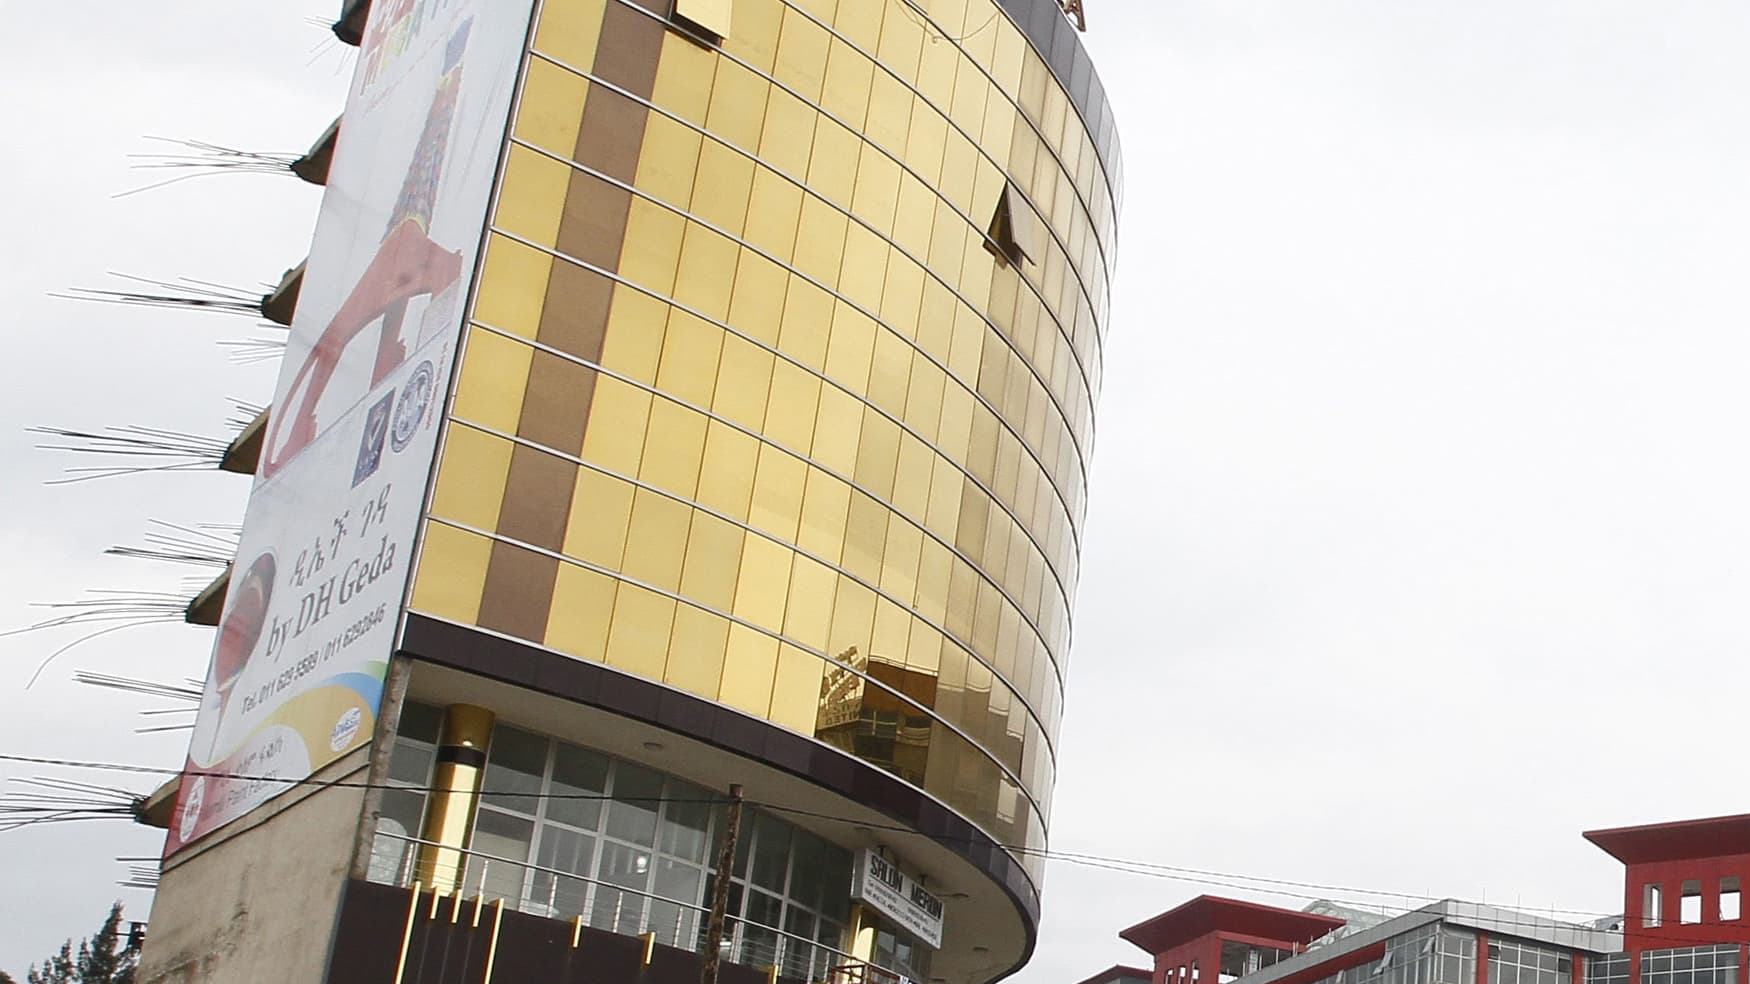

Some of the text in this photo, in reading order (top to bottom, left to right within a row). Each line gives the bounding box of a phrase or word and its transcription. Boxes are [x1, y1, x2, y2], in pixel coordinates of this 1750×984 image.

[266, 533, 397, 663] by DH Geda
[870, 855, 904, 893] SALON
